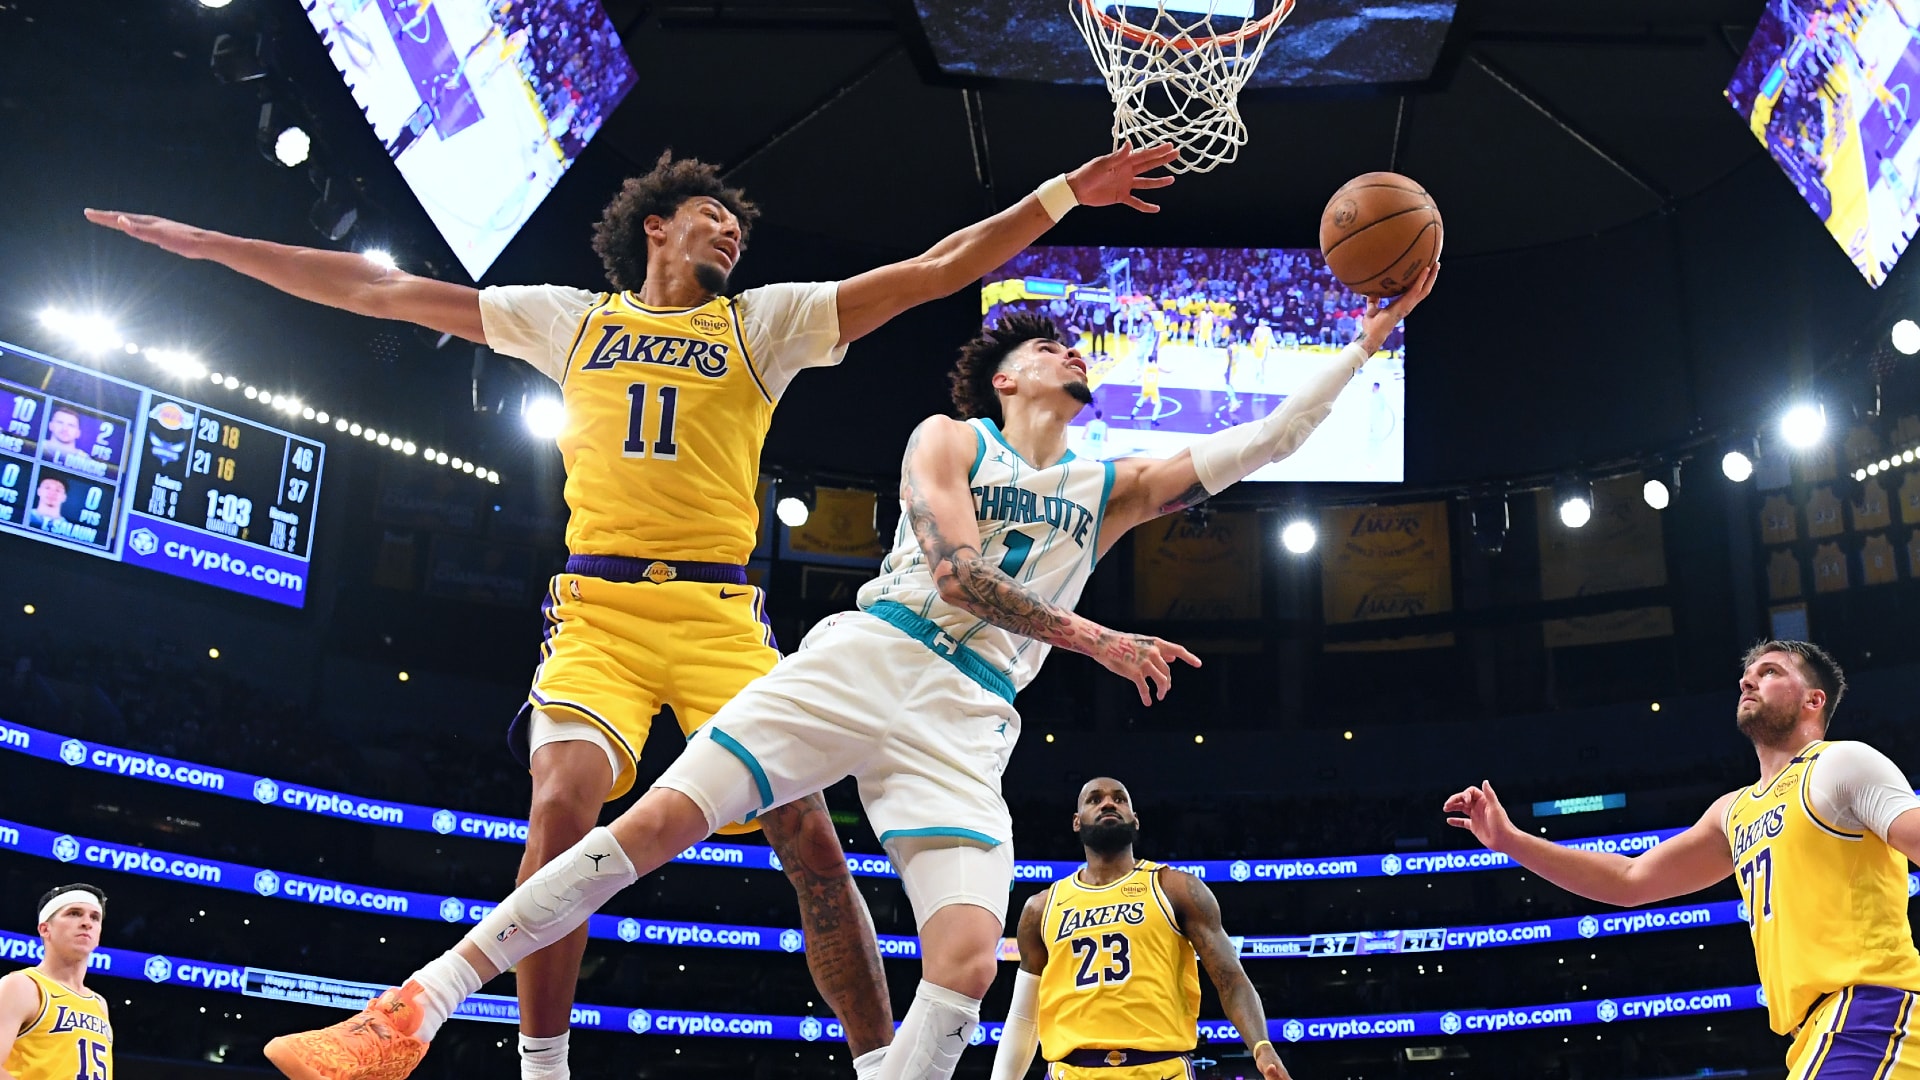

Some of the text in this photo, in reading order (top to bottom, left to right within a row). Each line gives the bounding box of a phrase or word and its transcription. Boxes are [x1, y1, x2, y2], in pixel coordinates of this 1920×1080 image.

[694, 318, 727, 330] bibigo
[581, 324, 729, 379] LAKERS
[12, 396, 37, 422] 10
[621, 382, 678, 461] 11
[96, 422, 114, 446] 2
[197, 417, 219, 443] 28
[222, 425, 240, 449] 18
[193, 449, 211, 475] 21
[217, 457, 235, 481] 16
[291, 446, 313, 472] 46
[1, 463, 20, 487] 0
[85, 486, 103, 510] 0
[287, 477, 309, 503] 37
[206, 489, 252, 527] 1:03
[970, 485, 1094, 549] CHARLOTTE
[164, 541, 302, 591] crypto.com
[998, 528, 1036, 579] 1
[92, 751, 224, 789] crypto.com
[283, 789, 403, 823] crypto.com
[460, 817, 529, 841] crypto
[1733, 803, 1787, 868] LAKERS
[85, 846, 221, 882] crypto.com
[1255, 861, 1357, 879] crypto.com
[1405, 852, 1509, 872] crypto.com
[285, 880, 407, 912] crypto.com
[1740, 845, 1773, 932] 77
[1054, 902, 1145, 943] LAKERS
[1603, 908, 1710, 932] crypto.com
[645, 926, 760, 945] crypto.com
[1252, 941, 1301, 954] Hornets
[1322, 937, 1347, 955] 37
[1410, 938, 1419, 950] 2
[1447, 925, 1551, 948] crypto.com
[1070, 931, 1133, 991] 23
[1623, 994, 1731, 1016] crypto.com
[48, 1004, 112, 1044] LAKER
[656, 1016, 772, 1034] crypto.com
[1309, 1019, 1414, 1038] crypto.com
[1466, 1009, 1571, 1030] crypto.com
[76, 1037, 107, 1080] 15
